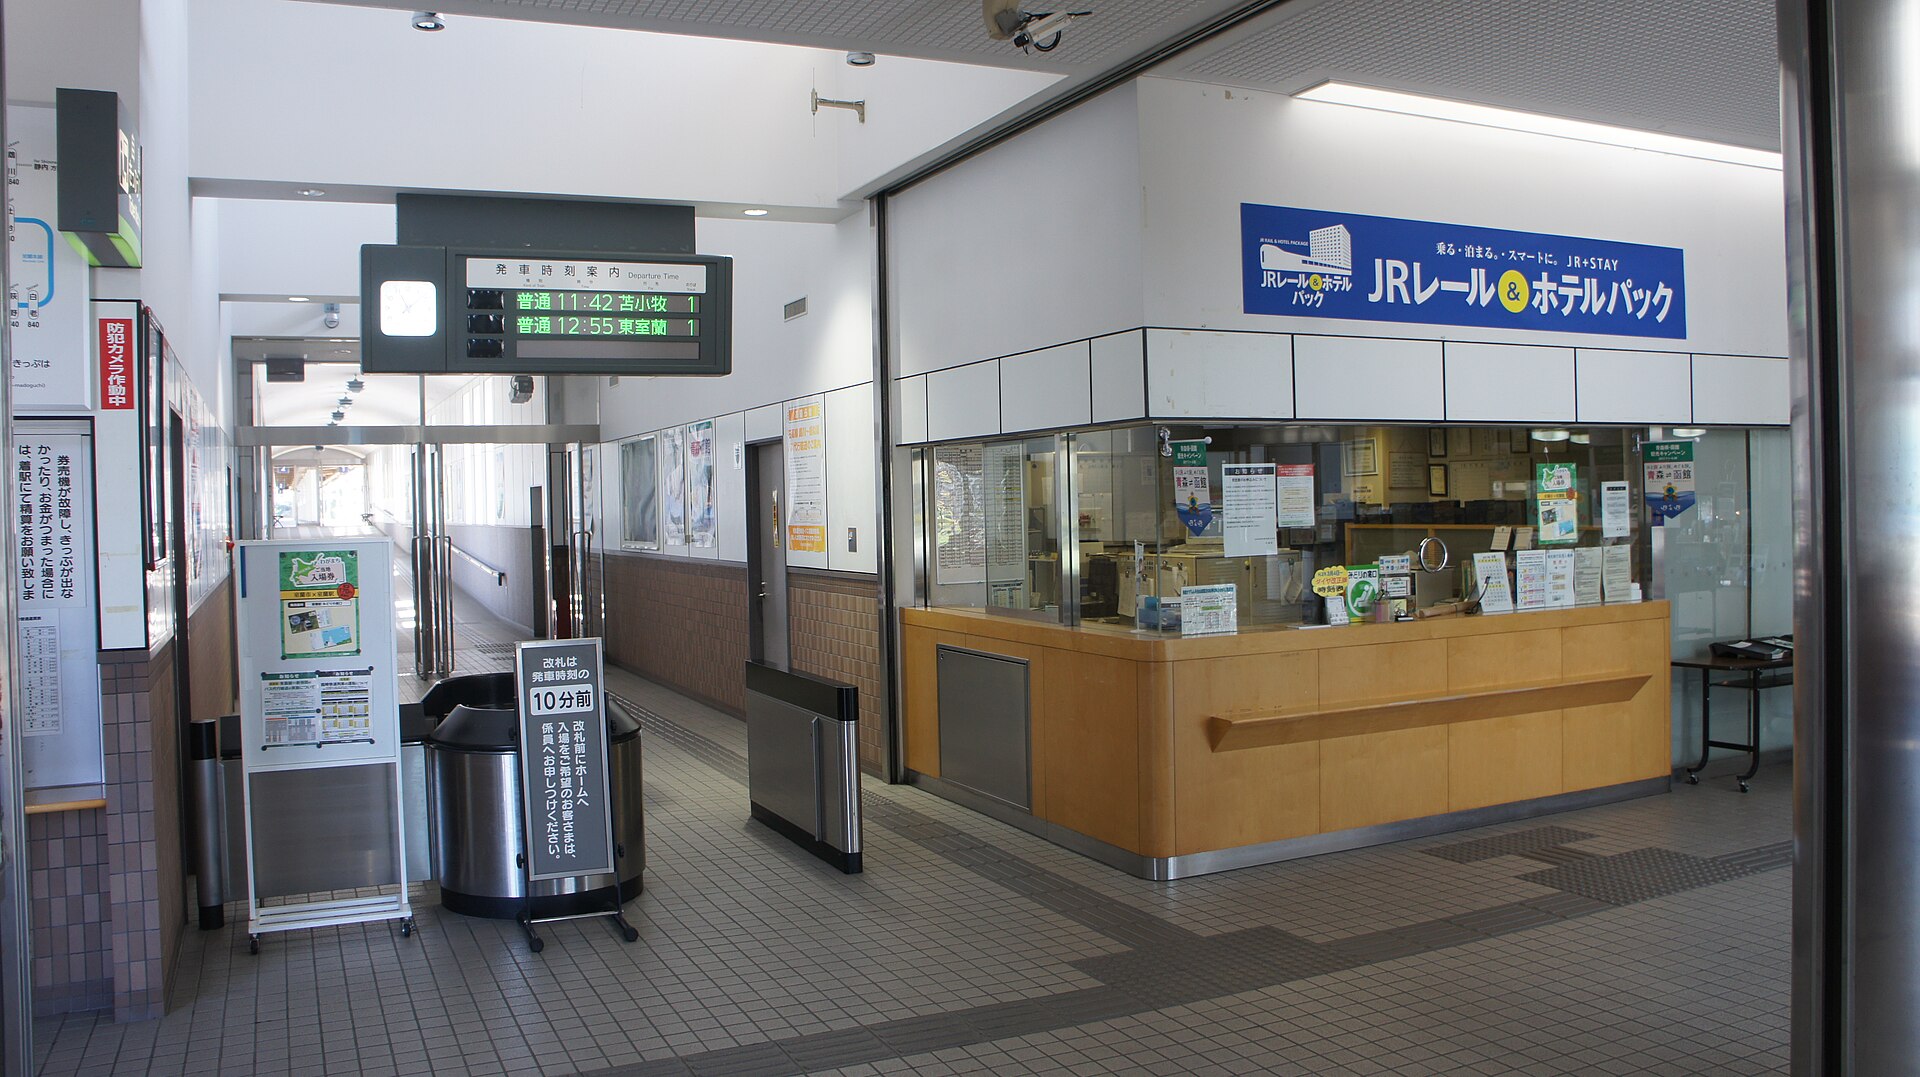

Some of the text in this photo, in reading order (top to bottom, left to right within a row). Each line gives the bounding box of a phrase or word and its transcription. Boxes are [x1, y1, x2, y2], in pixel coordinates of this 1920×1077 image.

[628, 271, 680, 281] Departure Time
[516, 292, 695, 313] 普通 11:42 苫小牧 1
[1292, 290, 1324, 308] パック
[516, 316, 695, 336] 普通 12:55 東室蘭 1
[107, 322, 126, 406] 防犯カメラ作動中
[18, 444, 35, 600] は、着駅にて精算をお願い致しま
[38, 445, 55, 600] かったり、お金がつまった場合に
[57, 454, 74, 599] 券売機が故障し、きっぷが出な
[311, 573, 335, 582] 入場券
[543, 656, 578, 669] 改札は
[532, 669, 590, 682] 発車時刻の
[533, 690, 591, 711] 10分前
[572, 721, 589, 806] 改札前にホームへ
[542, 723, 560, 859] 係員へお申しつけください。
[558, 722, 576, 858] 入場をご希望のお客さまは、
